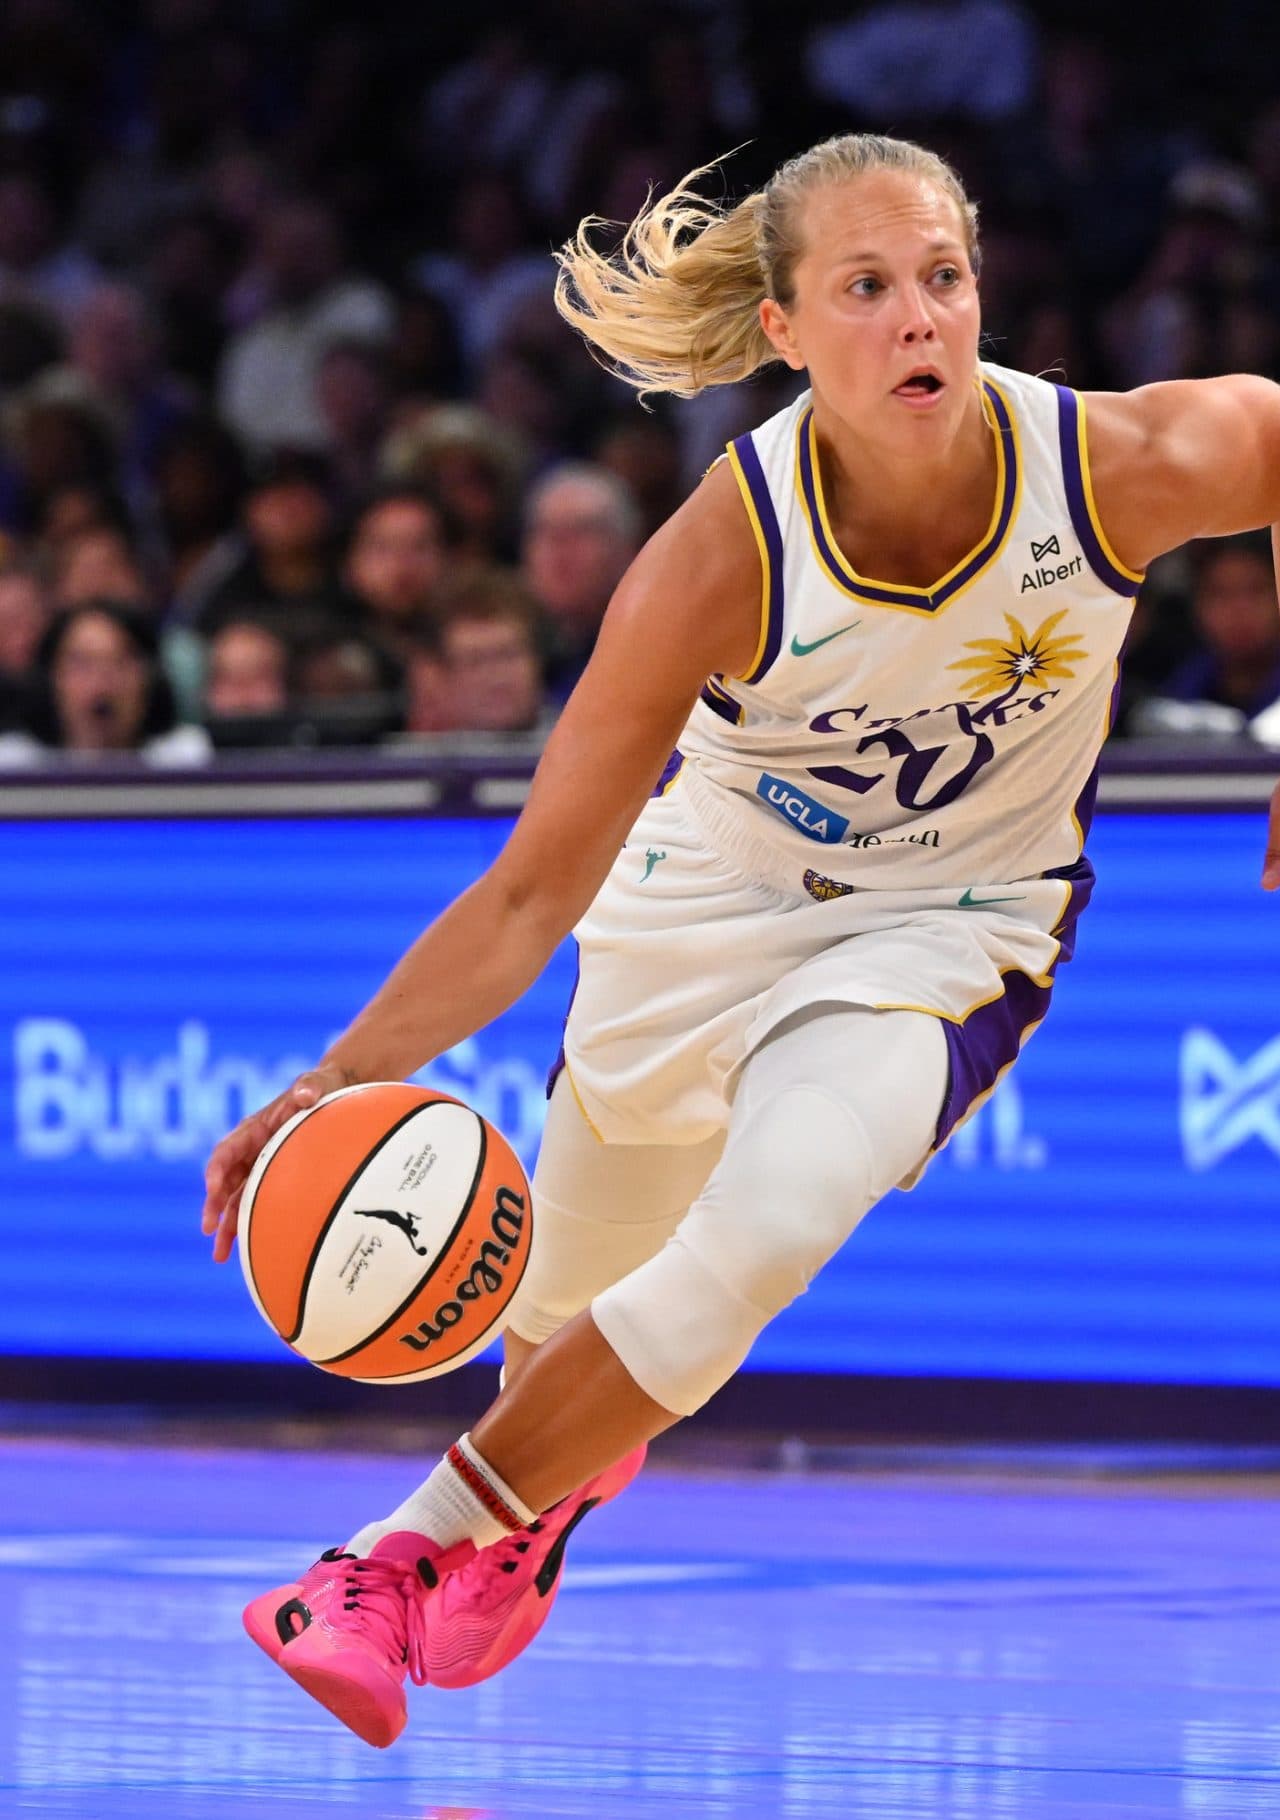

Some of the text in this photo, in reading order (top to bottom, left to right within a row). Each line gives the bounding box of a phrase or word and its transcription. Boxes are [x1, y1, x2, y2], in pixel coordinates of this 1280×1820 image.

[1020, 553, 1082, 594] Albert
[767, 784, 829, 840] UCLA
[400, 1186, 526, 1352] Wilson
